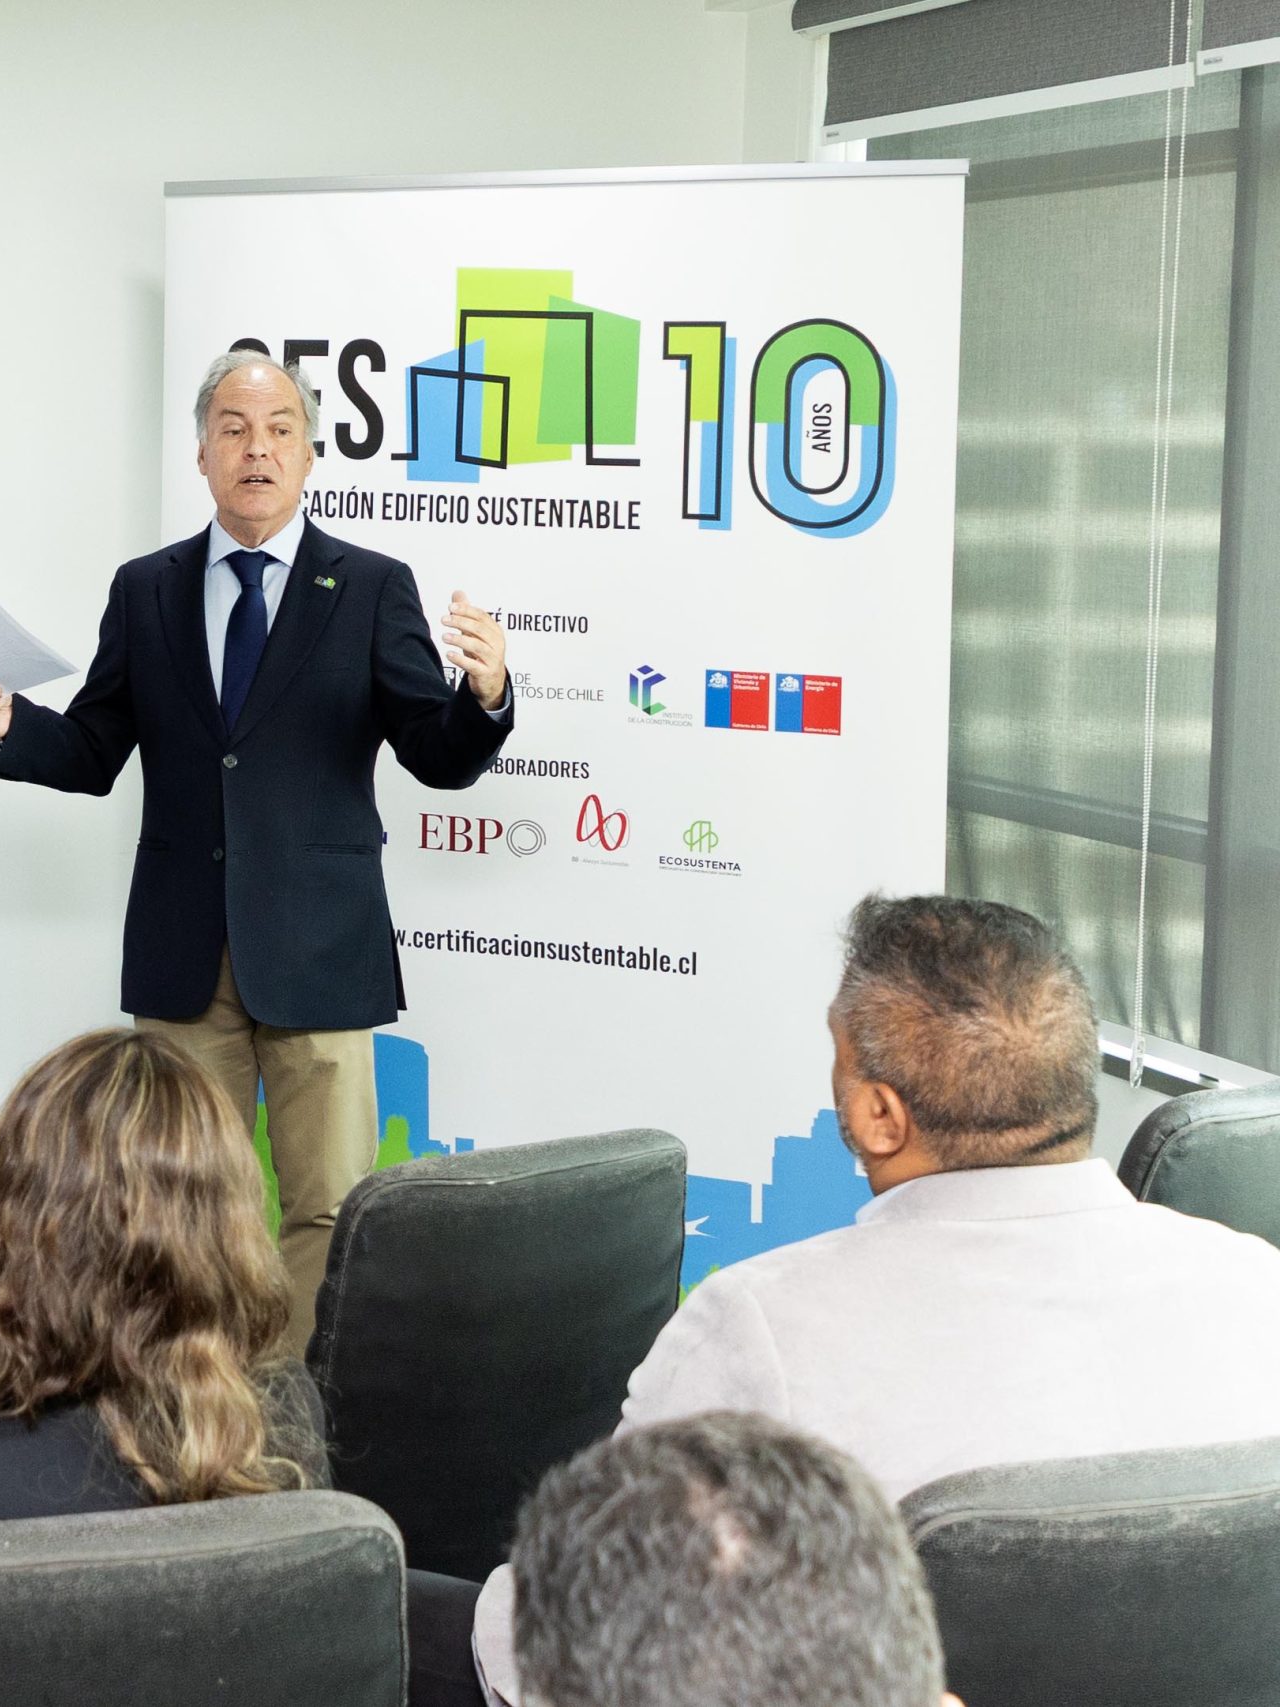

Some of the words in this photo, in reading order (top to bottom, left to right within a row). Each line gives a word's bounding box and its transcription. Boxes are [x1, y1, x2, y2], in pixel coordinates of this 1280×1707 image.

[228, 337, 386, 460] ES
[806, 402, 832, 453] AÑOS
[381, 492, 469, 525] EDIFICIO
[477, 496, 641, 530] SUSTENTABLE
[507, 612, 588, 634] DIRECTIVO
[514, 672, 531, 685] DE
[546, 687, 564, 700] DE
[567, 688, 604, 702] CHILE
[489, 757, 590, 779] BORADORES
[418, 812, 504, 854] EBP
[658, 855, 742, 871] ECOSUSTENTA
